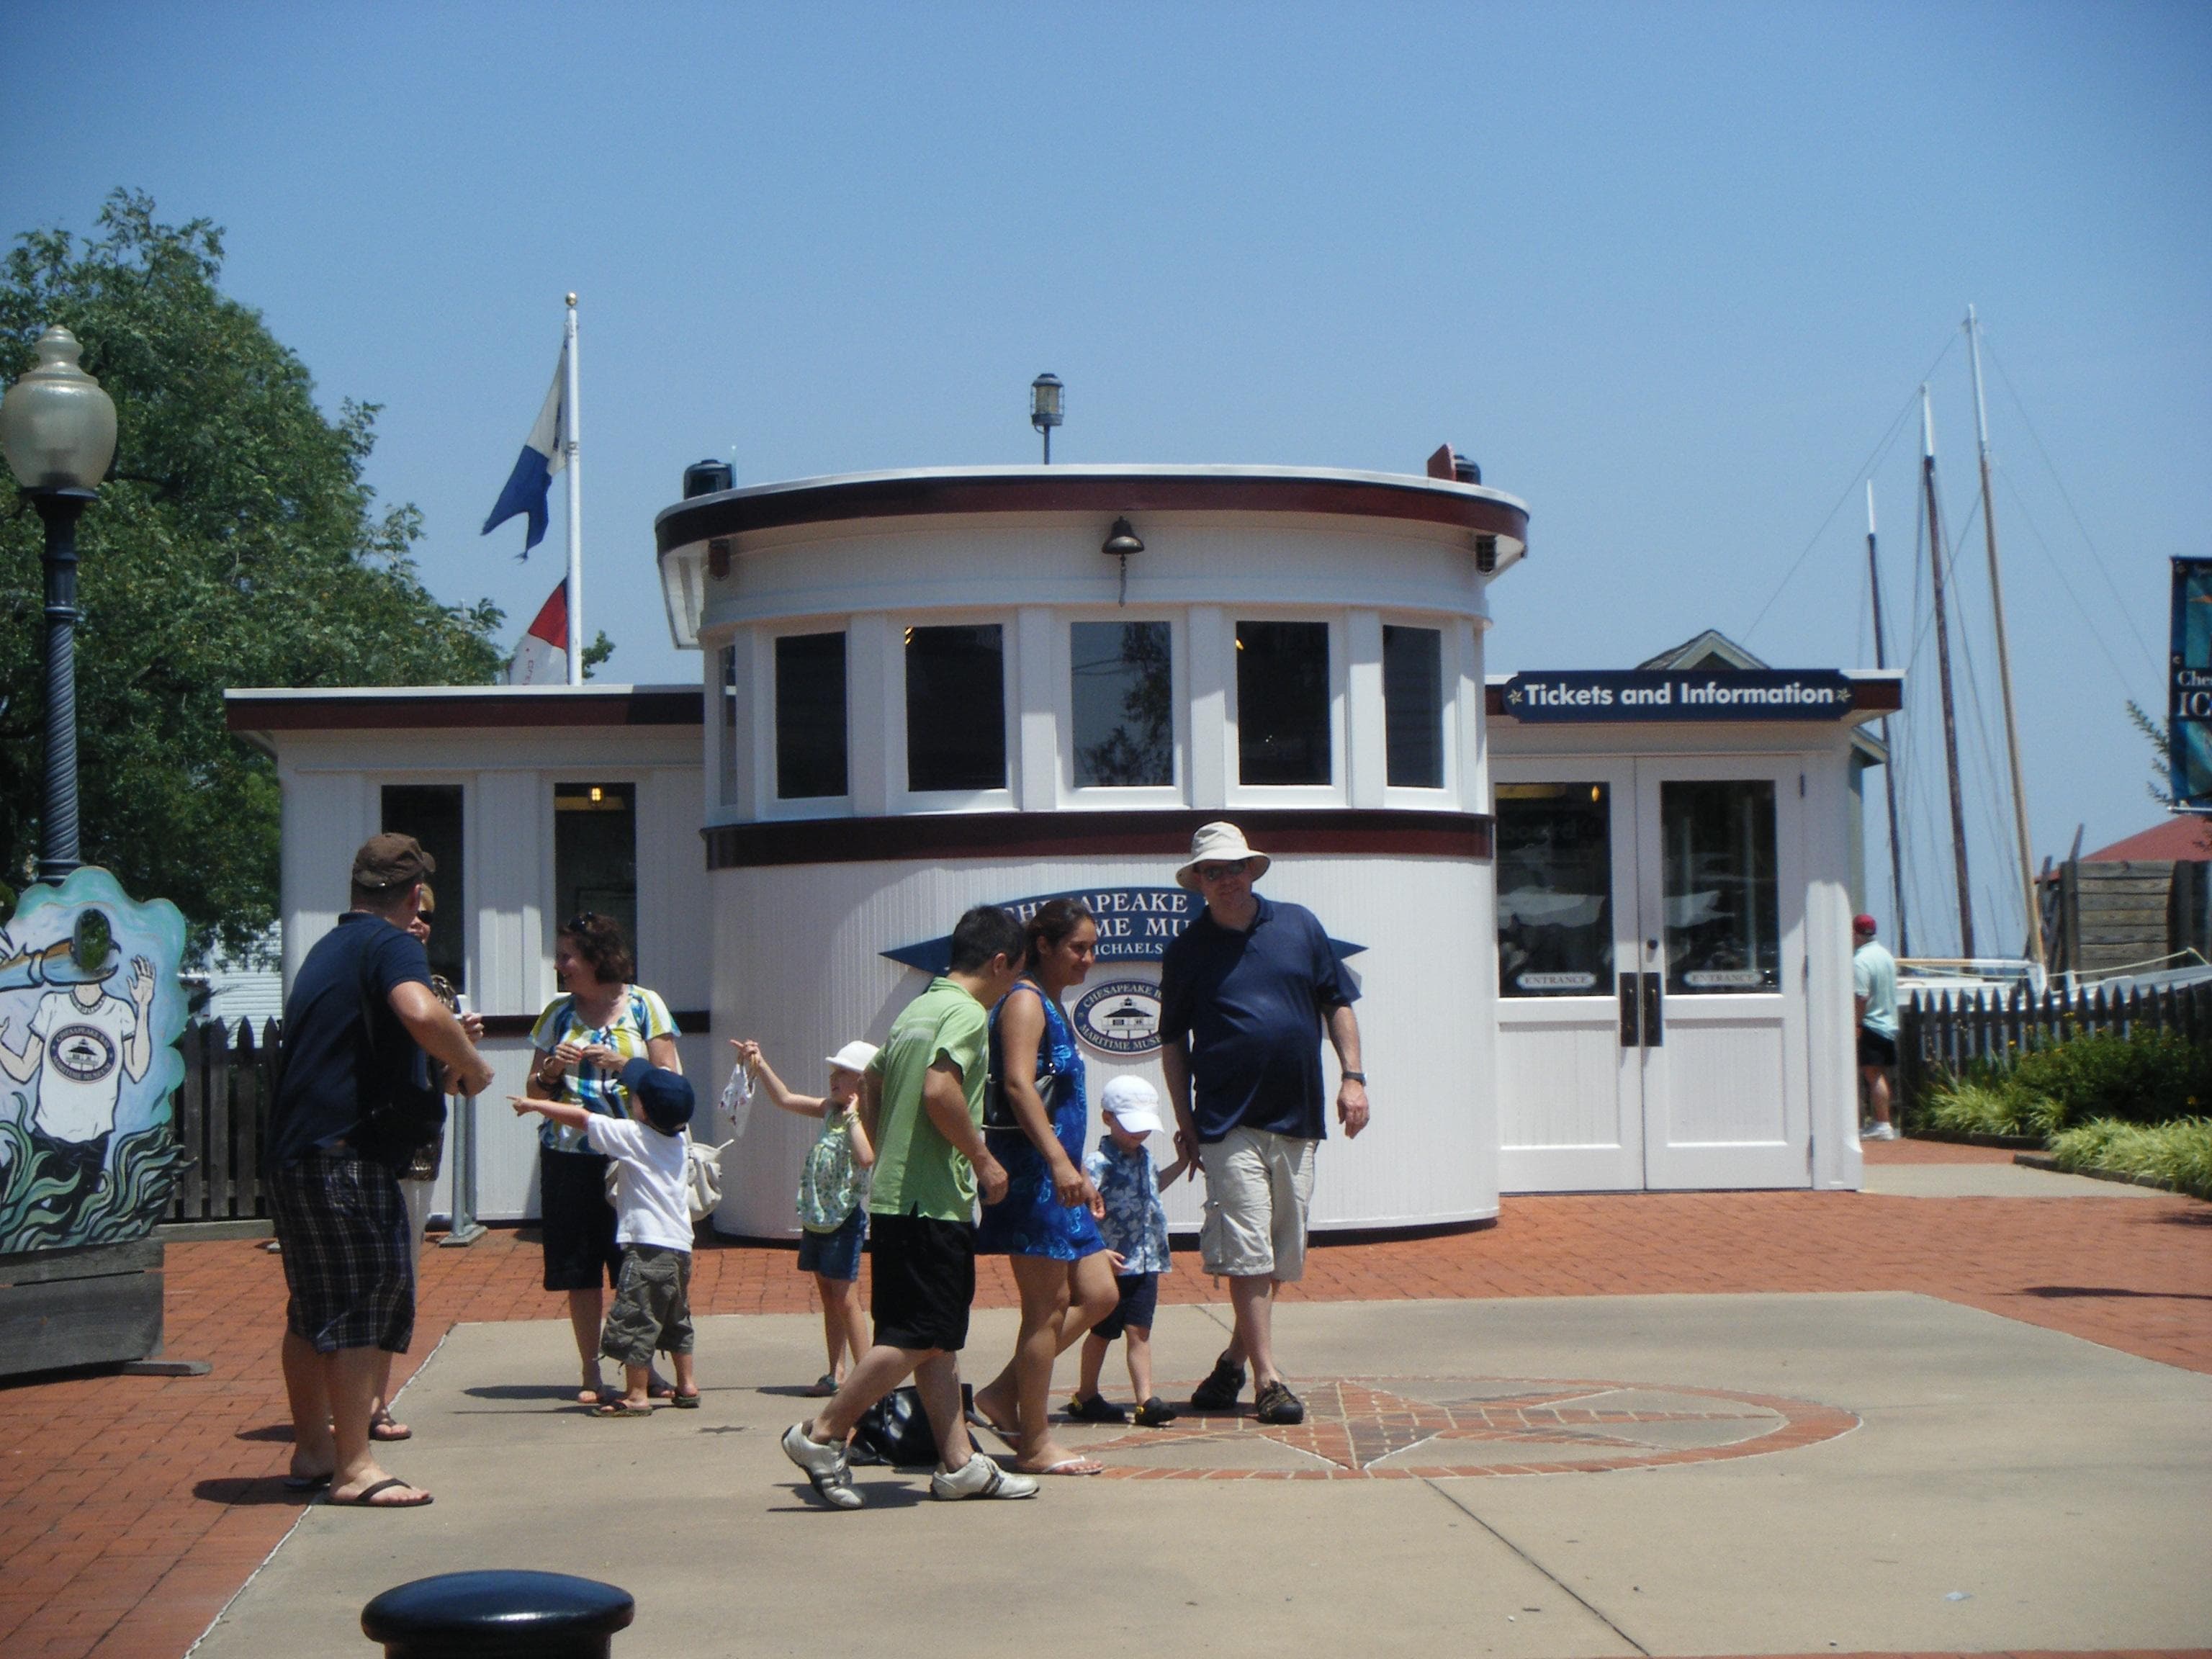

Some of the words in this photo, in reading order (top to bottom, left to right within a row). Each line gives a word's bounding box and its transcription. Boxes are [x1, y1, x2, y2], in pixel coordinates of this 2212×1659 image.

[1524, 683, 1614, 705] Tickets
[1621, 683, 1671, 704] and
[1680, 681, 1834, 703] Information
[1003, 893, 1188, 924] HAPEAKE
[1525, 976, 1587, 984] ENTRANCE
[1083, 984, 1152, 1008] CHESAPEAKE
[1079, 1024, 1130, 1049] MARITIME
